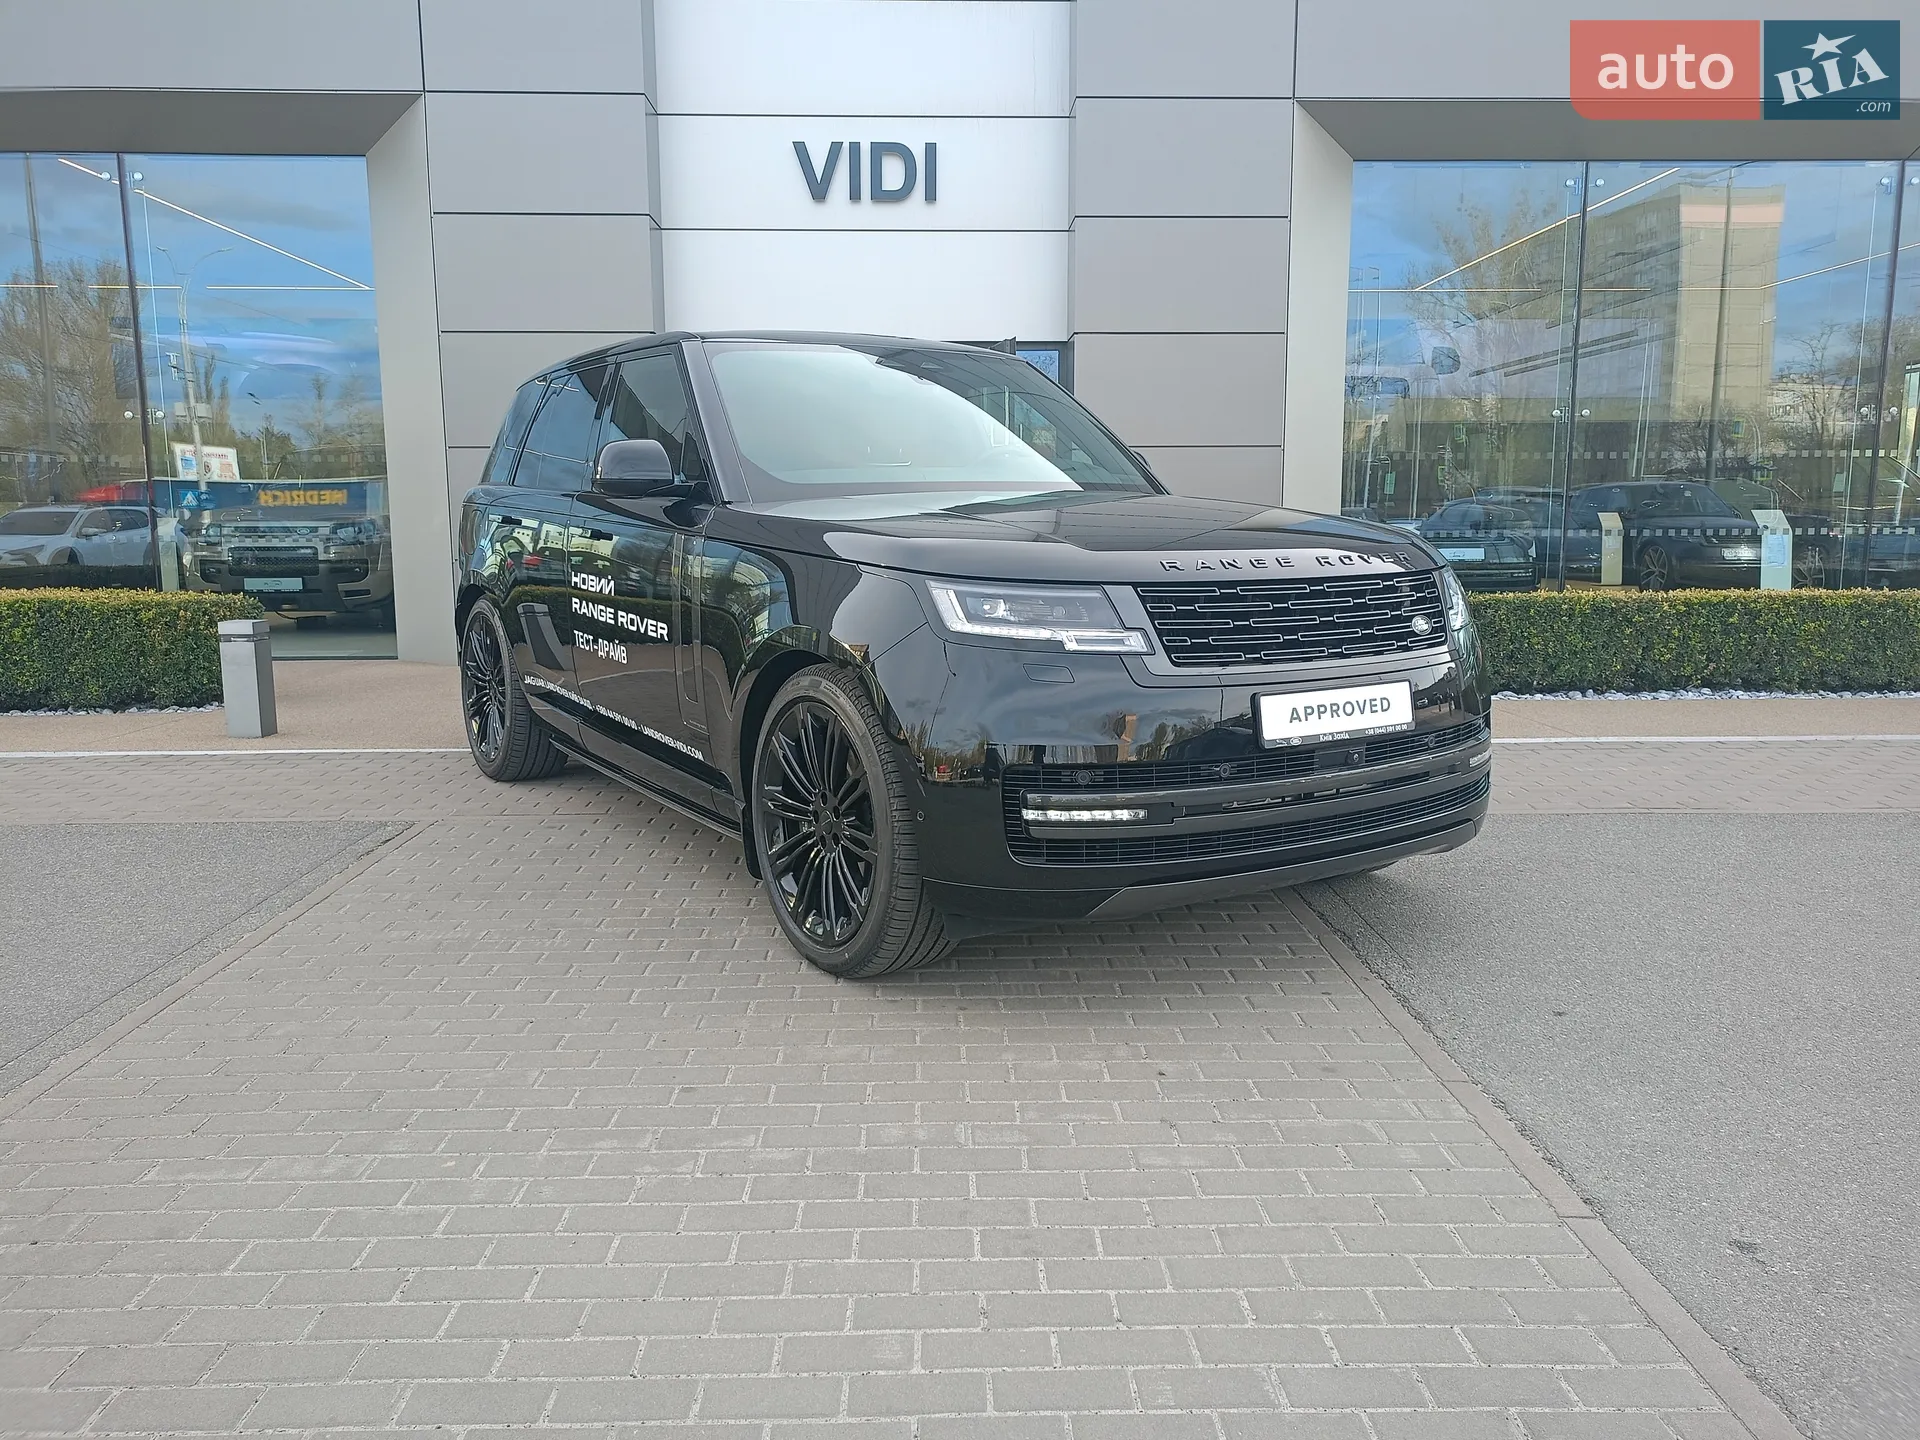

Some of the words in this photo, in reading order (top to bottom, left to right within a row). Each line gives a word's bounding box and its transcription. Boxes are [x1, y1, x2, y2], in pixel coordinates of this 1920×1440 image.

[792, 141, 937, 202] VIDI
[1160, 558, 1295, 572] RANGE
[1315, 551, 1412, 567] ROVER
[571, 571, 615, 596] НОВИЙ
[571, 597, 615, 625] RANGE
[617, 610, 669, 641] ROVER
[573, 629, 628, 664] ТЕСТ-ДРАЙВ
[1289, 697, 1391, 723] APPROVED
